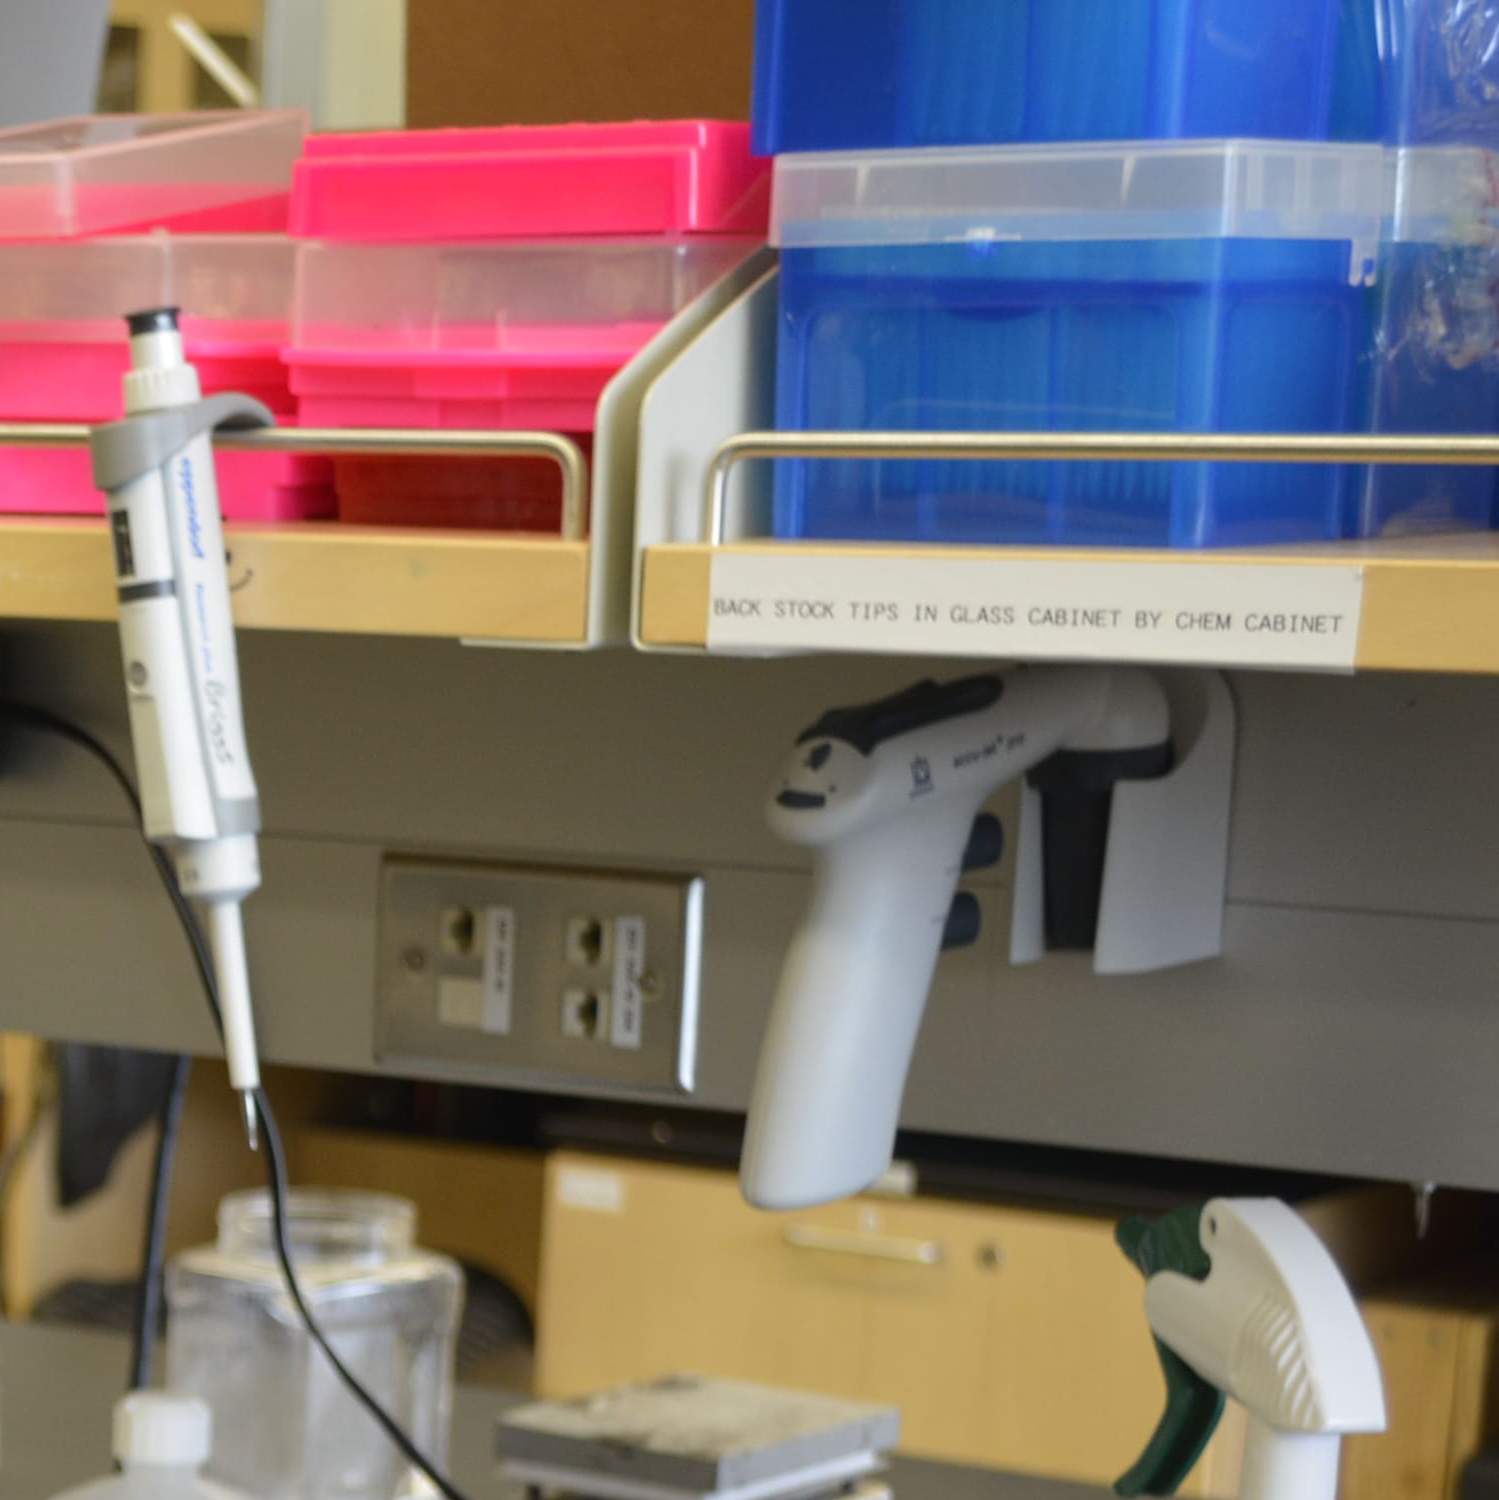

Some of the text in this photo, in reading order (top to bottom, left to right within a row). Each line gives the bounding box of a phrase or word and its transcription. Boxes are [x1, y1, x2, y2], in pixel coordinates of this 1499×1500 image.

[713, 598, 1345, 635] BACK STOCK TIPS IN GLASS CABINET BY CHEM CABINET
